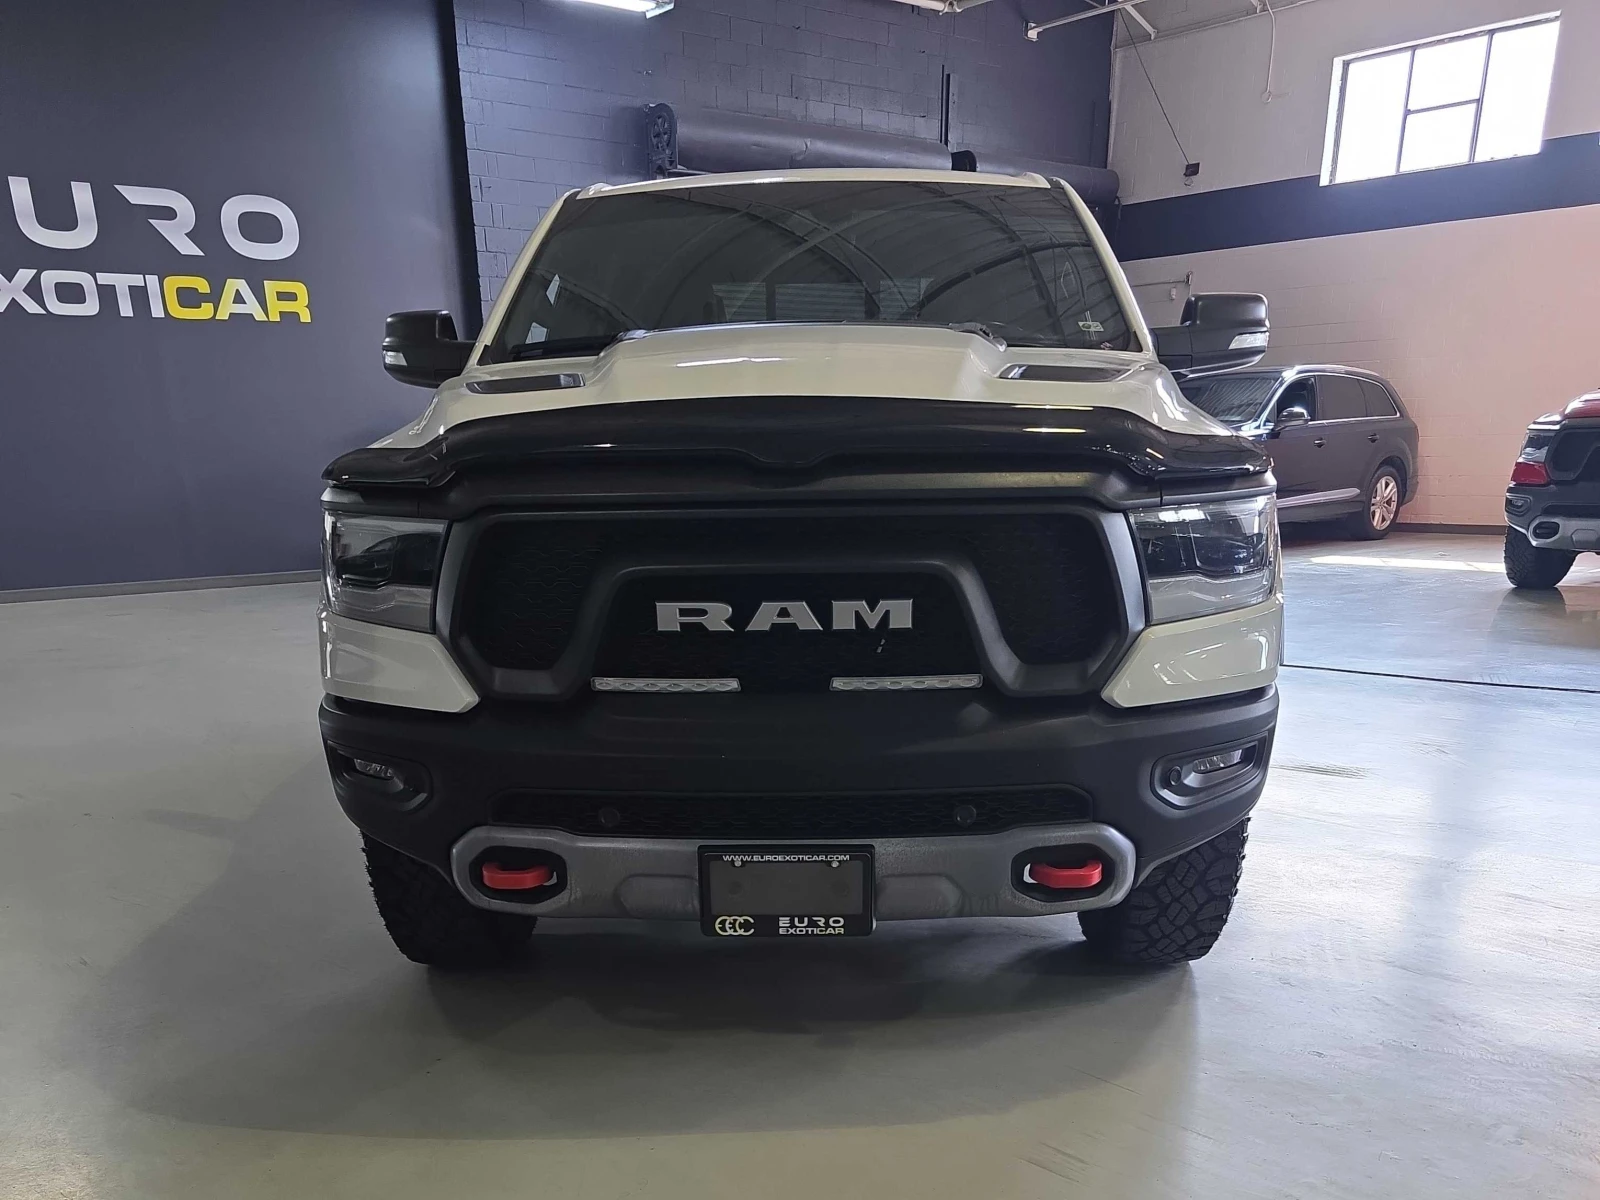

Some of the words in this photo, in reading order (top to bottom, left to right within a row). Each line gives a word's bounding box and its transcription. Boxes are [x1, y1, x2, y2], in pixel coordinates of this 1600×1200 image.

[655, 599, 913, 632] RAM
[778, 917, 845, 927] EURO
[779, 927, 845, 935] EXOTICAR
